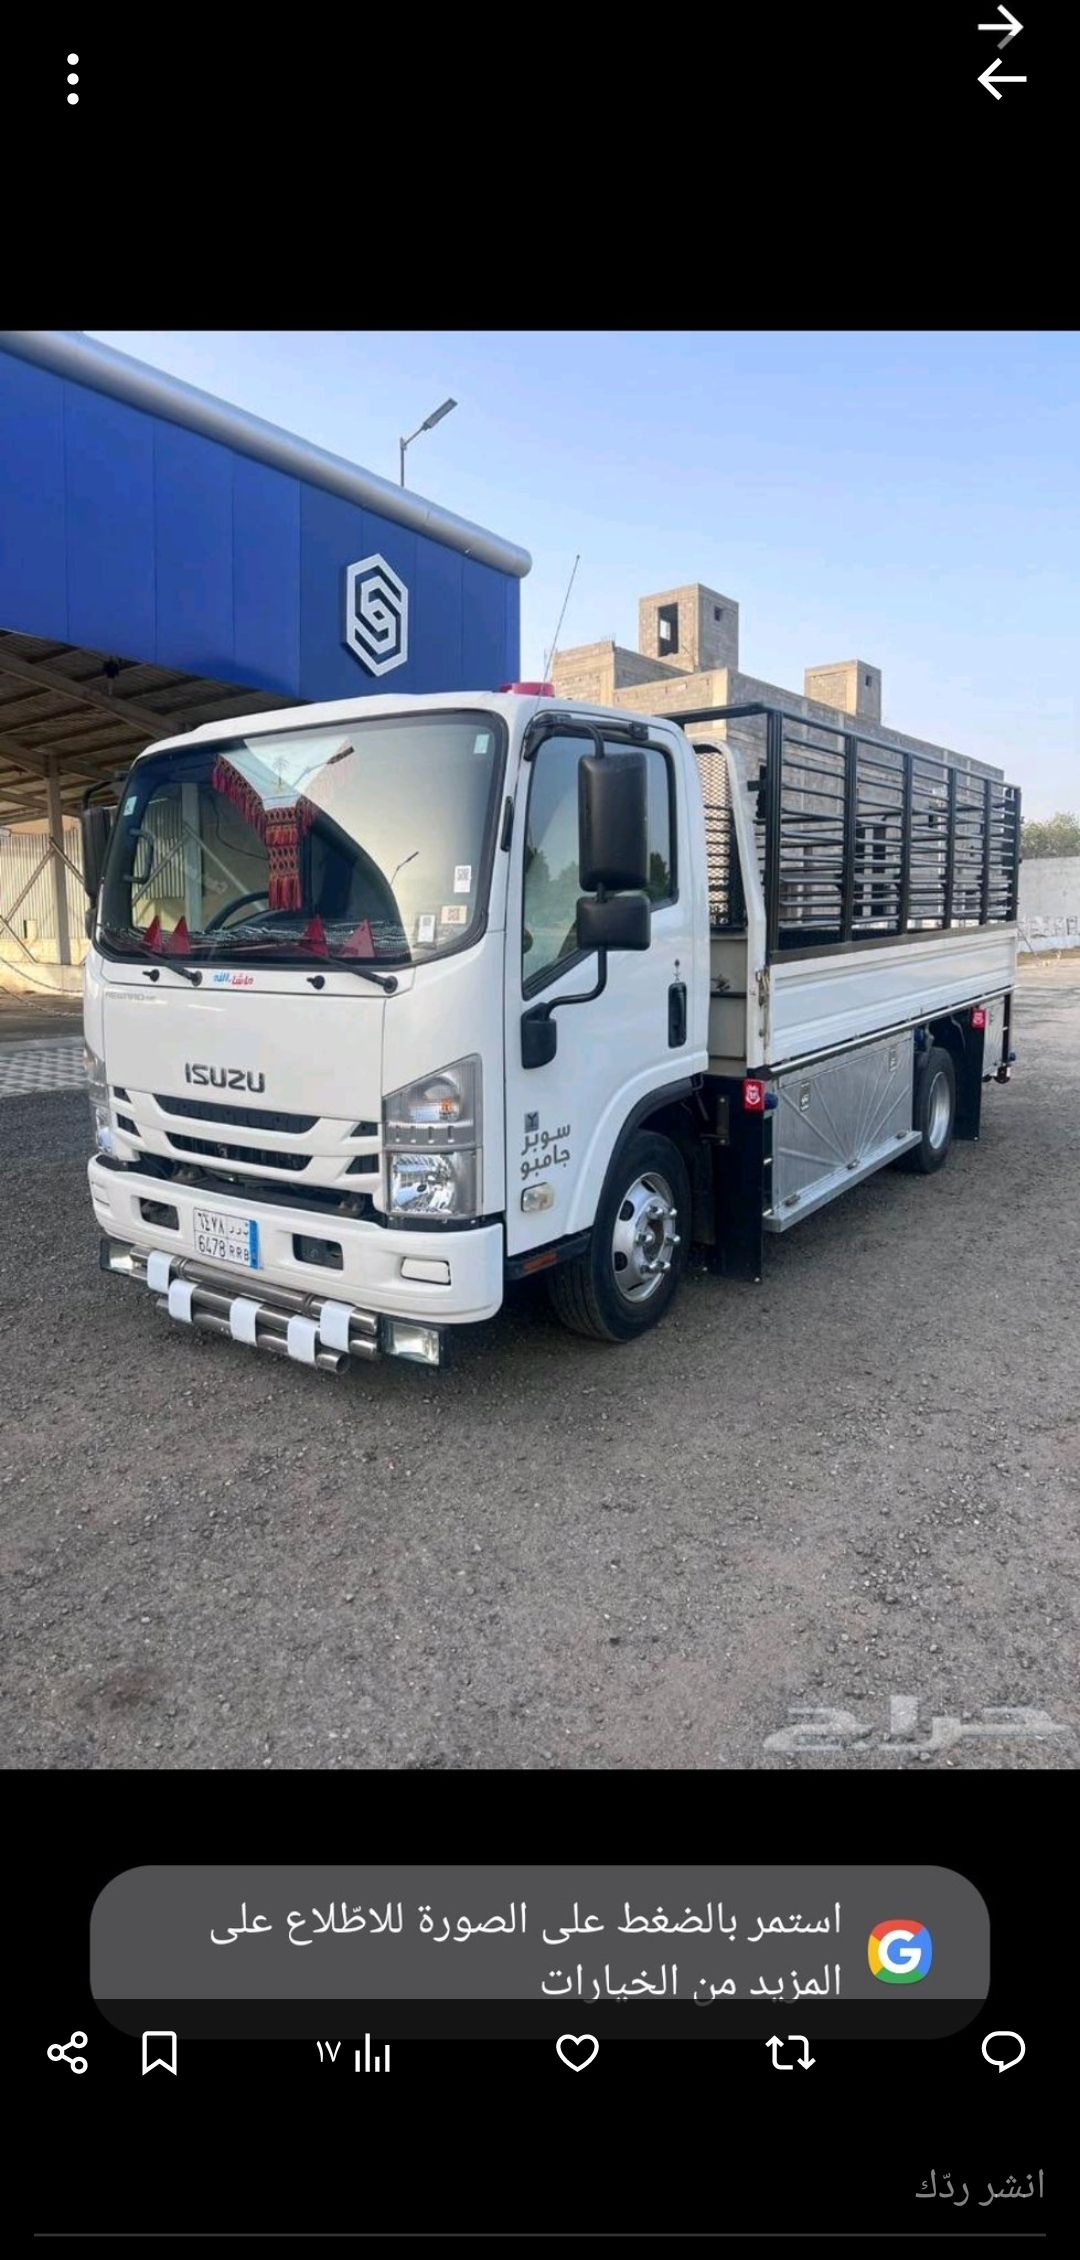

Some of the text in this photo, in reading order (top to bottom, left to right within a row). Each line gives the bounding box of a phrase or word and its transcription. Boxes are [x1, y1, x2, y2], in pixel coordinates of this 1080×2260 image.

[185, 1062, 266, 1093] ISUZU
[521, 1124, 570, 1156] سوبر
[520, 1144, 570, 1180] جامبو
[198, 1235, 226, 1258] 6478
